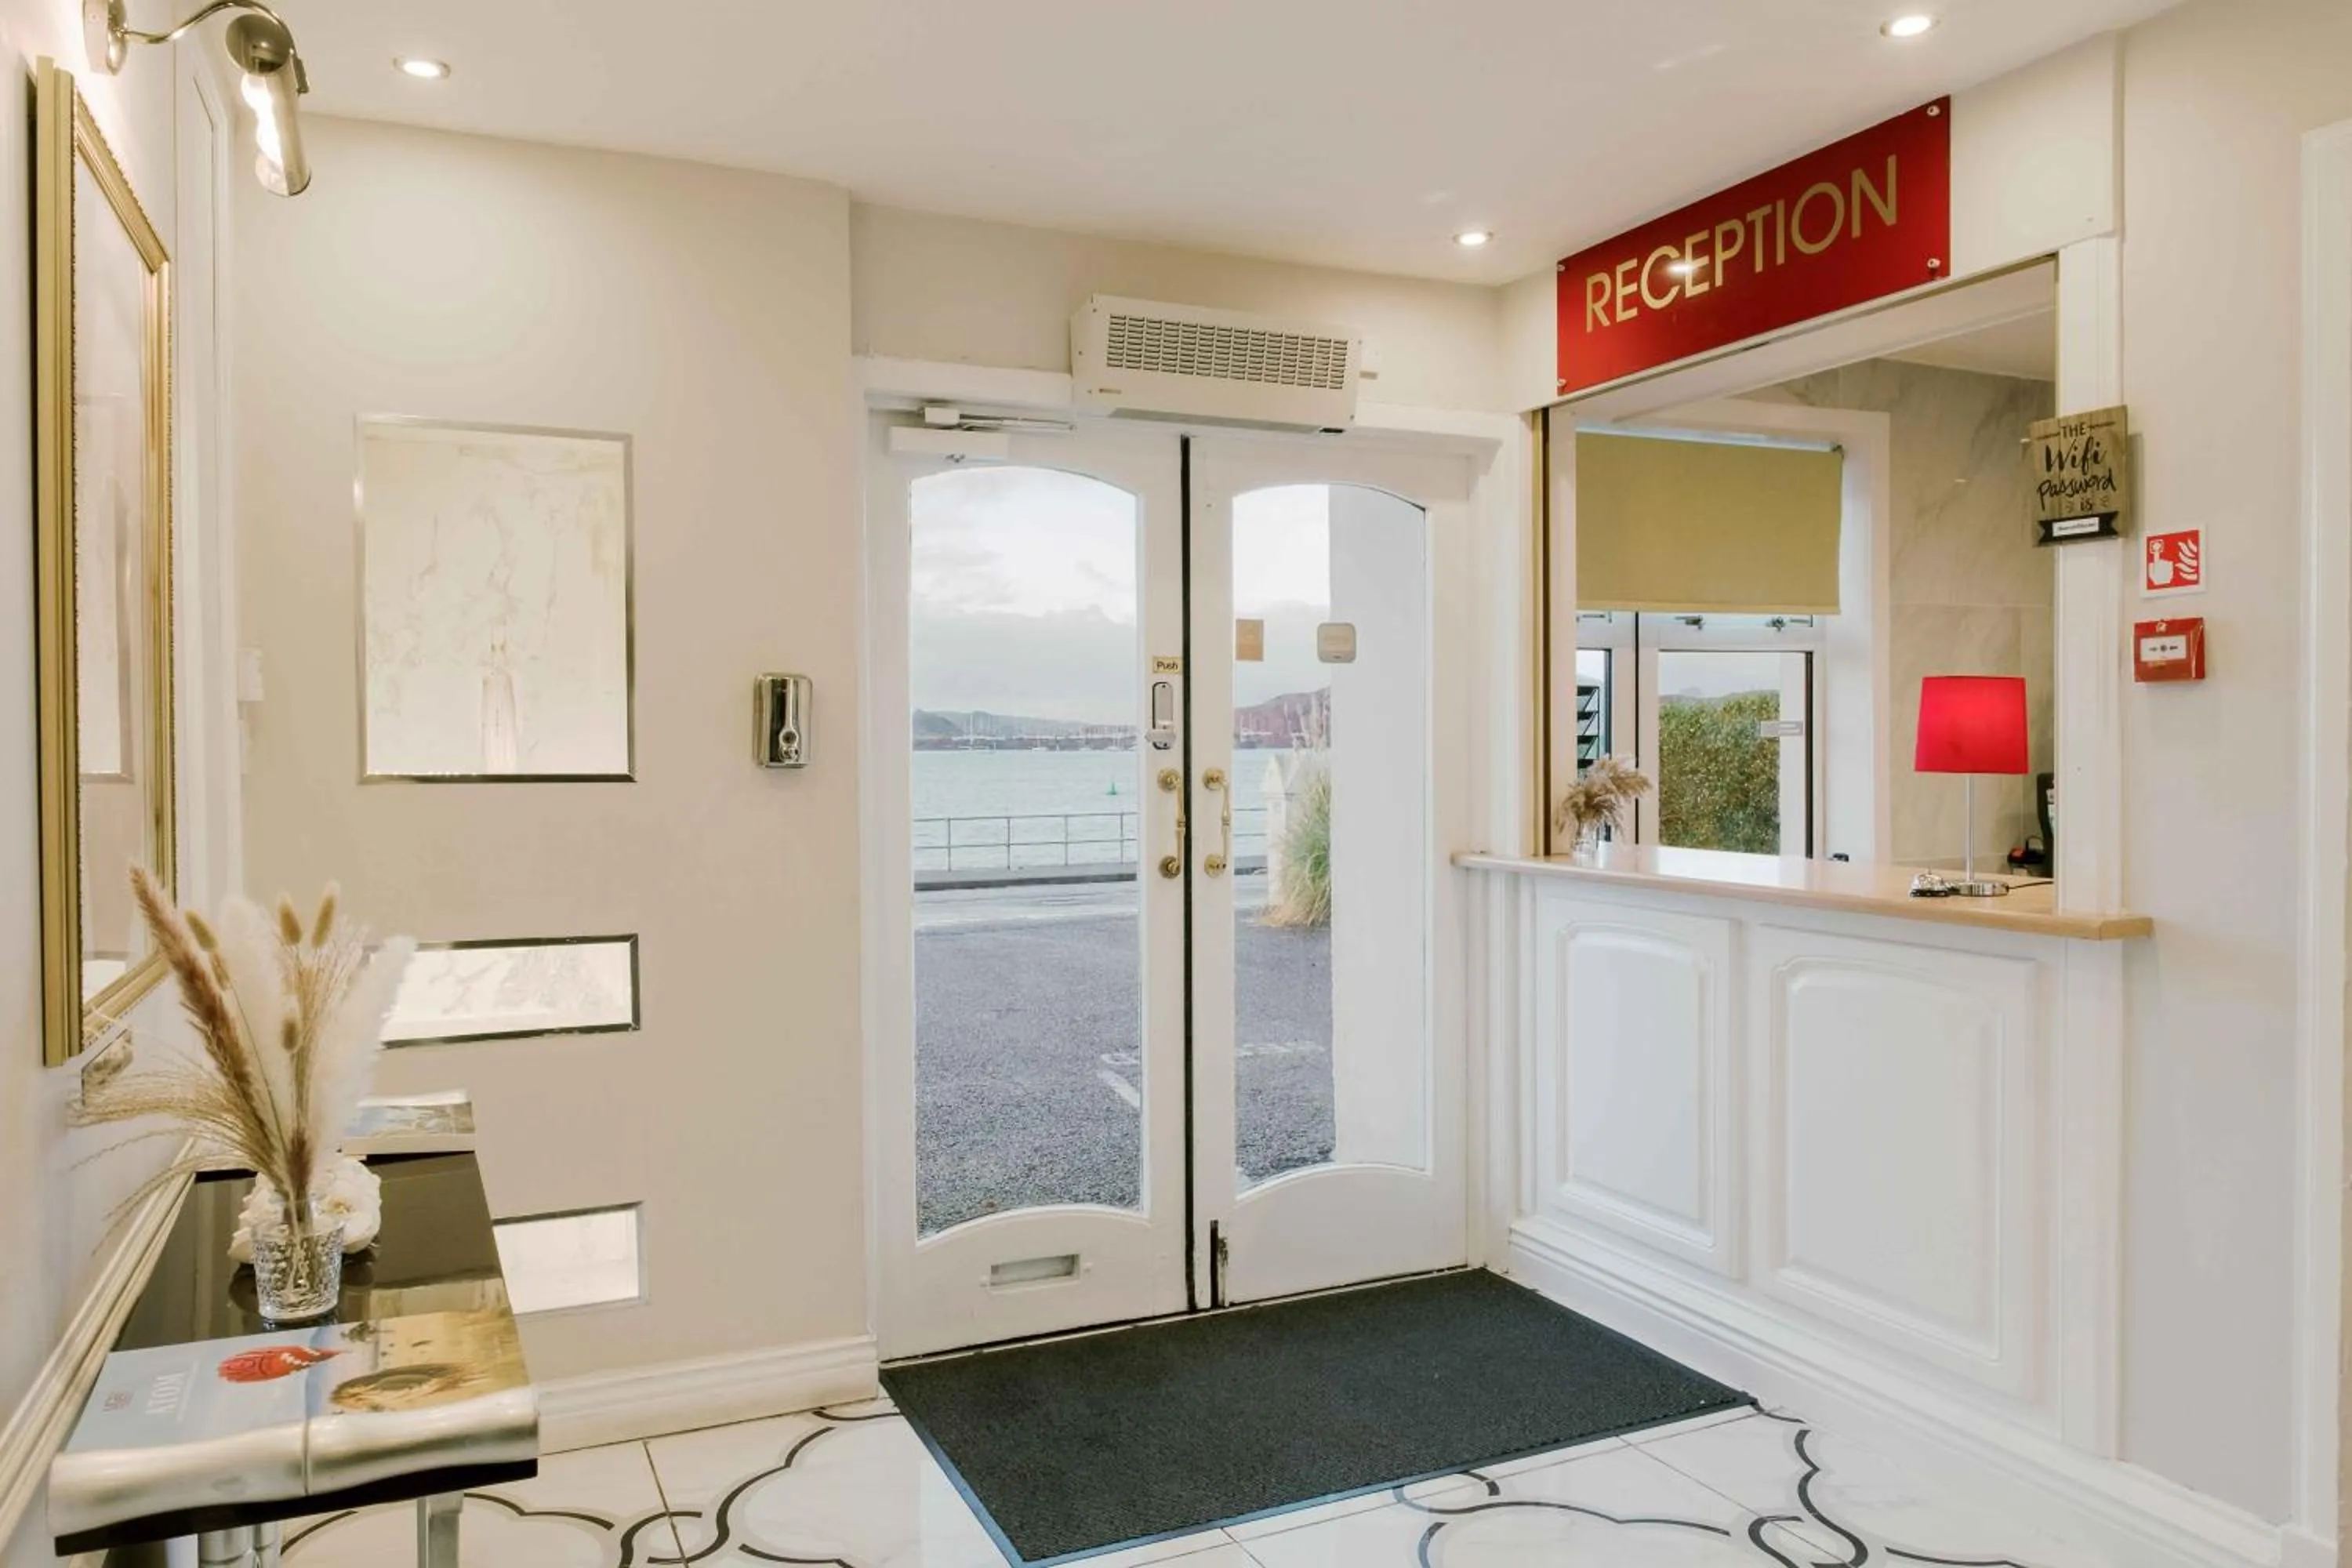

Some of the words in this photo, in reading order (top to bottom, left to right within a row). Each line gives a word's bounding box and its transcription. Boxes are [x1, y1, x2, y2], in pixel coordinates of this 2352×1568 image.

[1585, 154, 1897, 333] RECEPTION
[2061, 422, 2085, 439] THE
[2045, 436, 2107, 476] Wifi
[2080, 497, 2093, 510] is
[1156, 660, 1178, 670] Push
